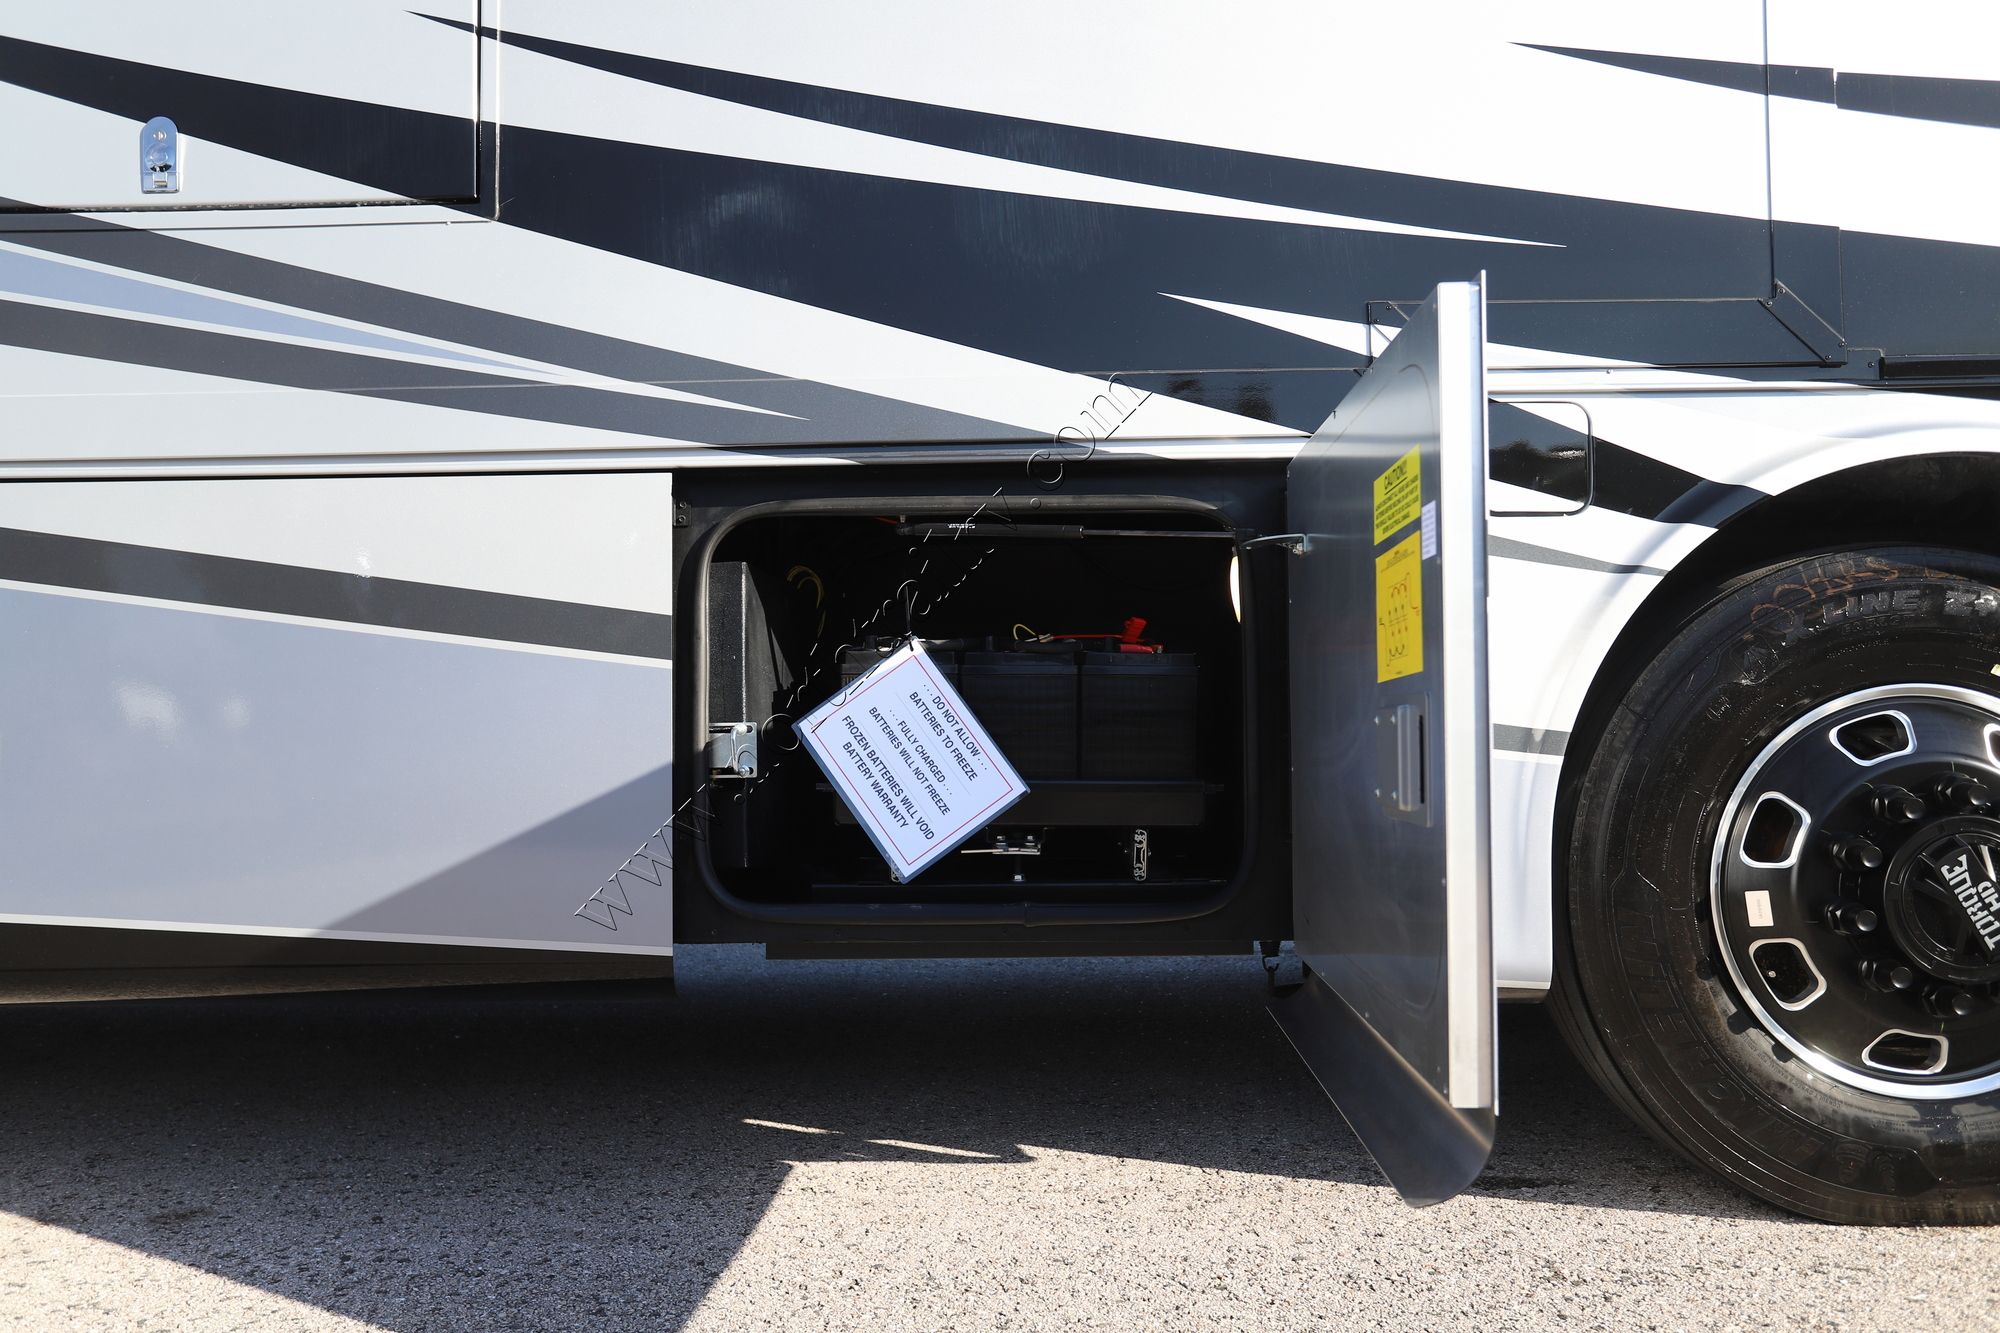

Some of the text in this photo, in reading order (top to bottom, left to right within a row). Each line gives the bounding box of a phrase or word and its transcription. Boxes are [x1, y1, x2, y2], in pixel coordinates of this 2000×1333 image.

[869, 707, 950, 815] BATTERIES WILL NOT FREEZE
[910, 692, 977, 781] BATTERIES TO FREEZE
[942, 709, 959, 727] NOT
[842, 715, 934, 839] FROZEN BATTERIES WILL VOID
[843, 742, 909, 827] BATTERY WARRANTY
[1940, 853, 2000, 952] TORQUE
[1976, 880, 2000, 908] HD
